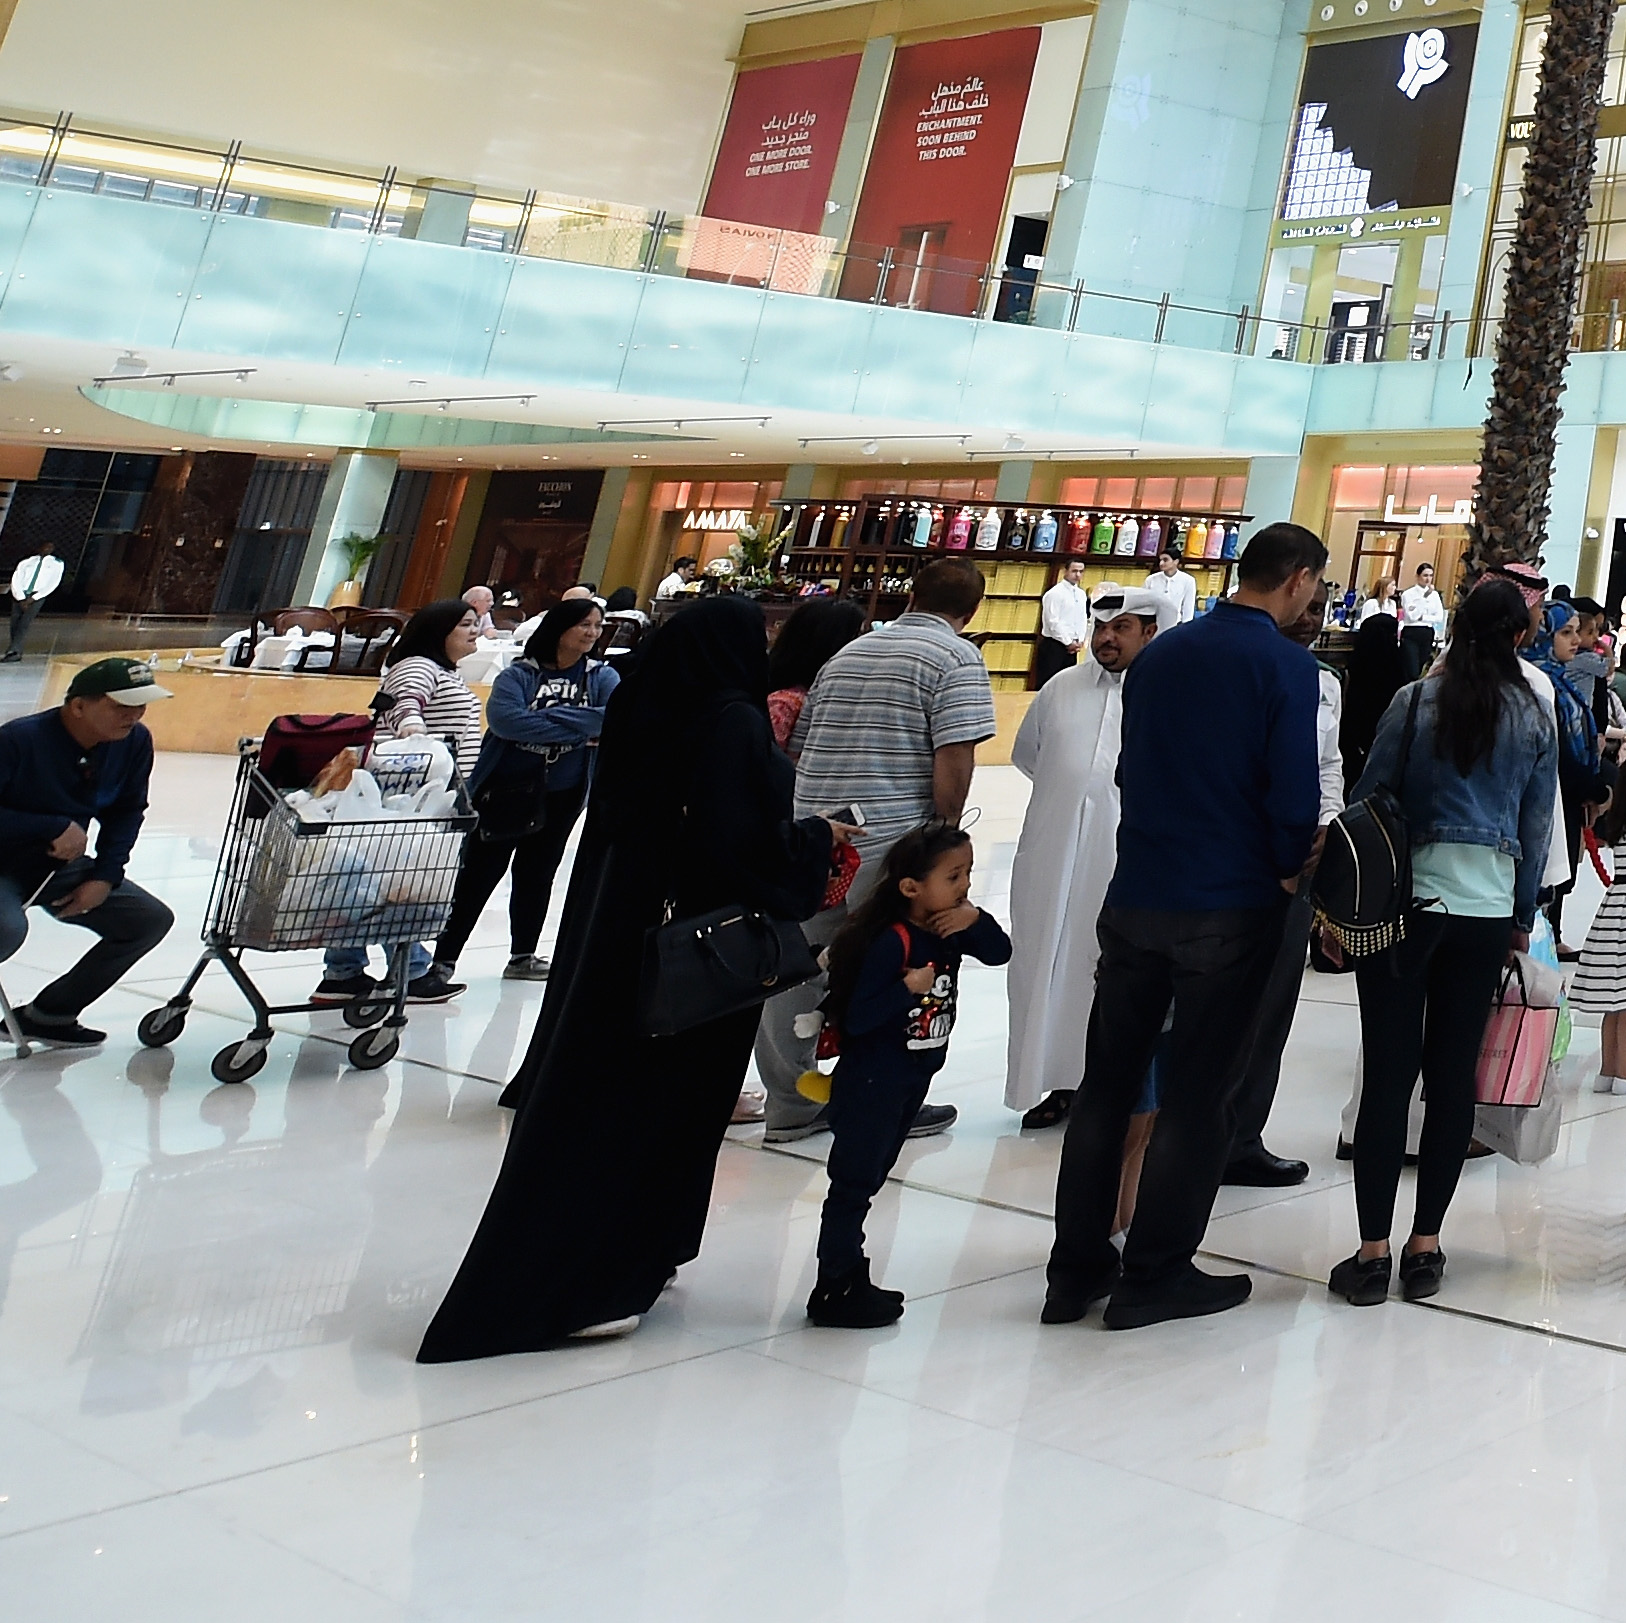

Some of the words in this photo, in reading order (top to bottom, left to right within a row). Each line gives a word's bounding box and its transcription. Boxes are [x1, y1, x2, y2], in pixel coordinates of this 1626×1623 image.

[916, 133, 942, 147] SOON
[942, 129, 977, 144] BEHIND
[918, 149, 939, 161] THIS
